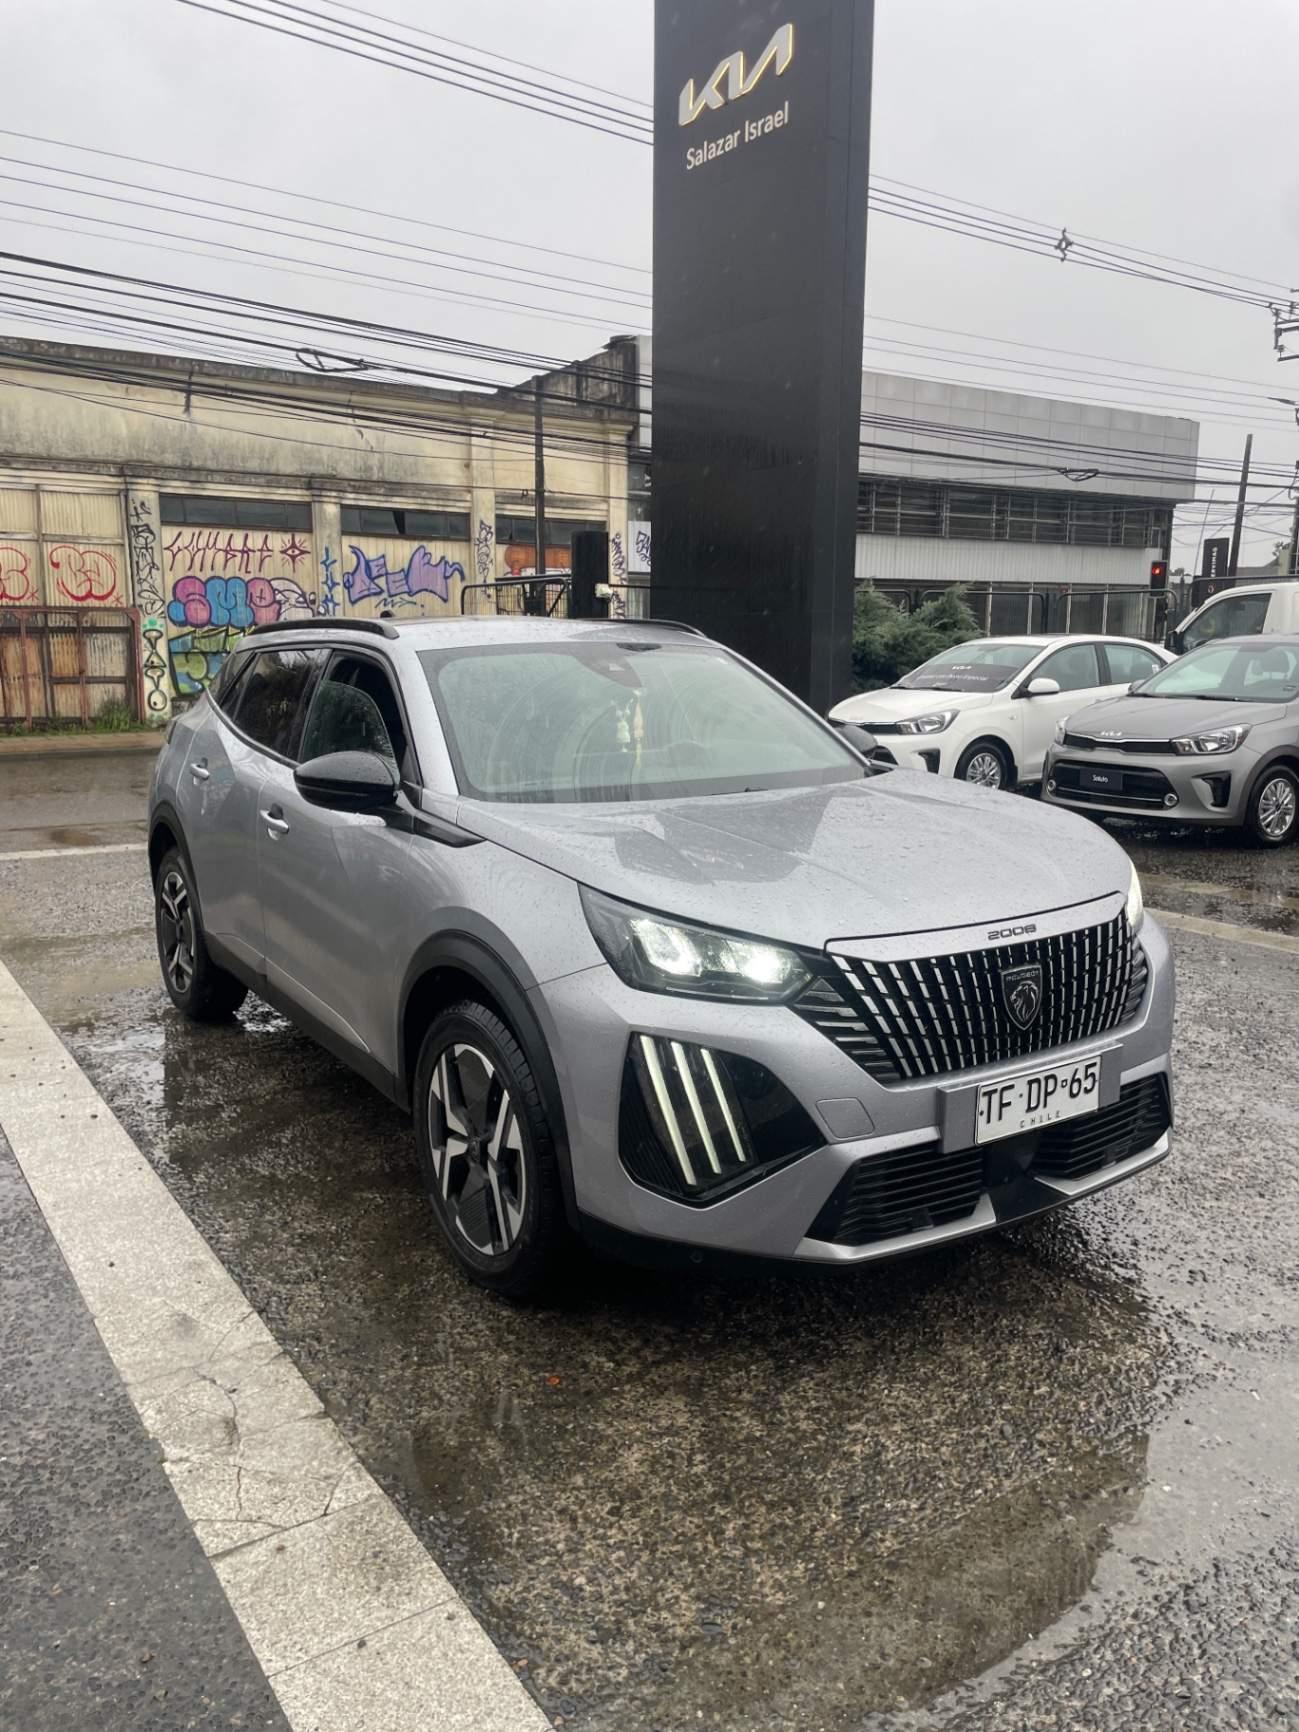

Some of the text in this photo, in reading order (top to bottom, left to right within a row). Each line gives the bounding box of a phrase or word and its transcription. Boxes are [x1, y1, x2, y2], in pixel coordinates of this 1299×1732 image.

[678, 23, 793, 127] KIA
[686, 100, 789, 170] Salazar Israel
[987, 923, 1037, 941] 2008
[1019, 1110, 1061, 1129] CHILE
